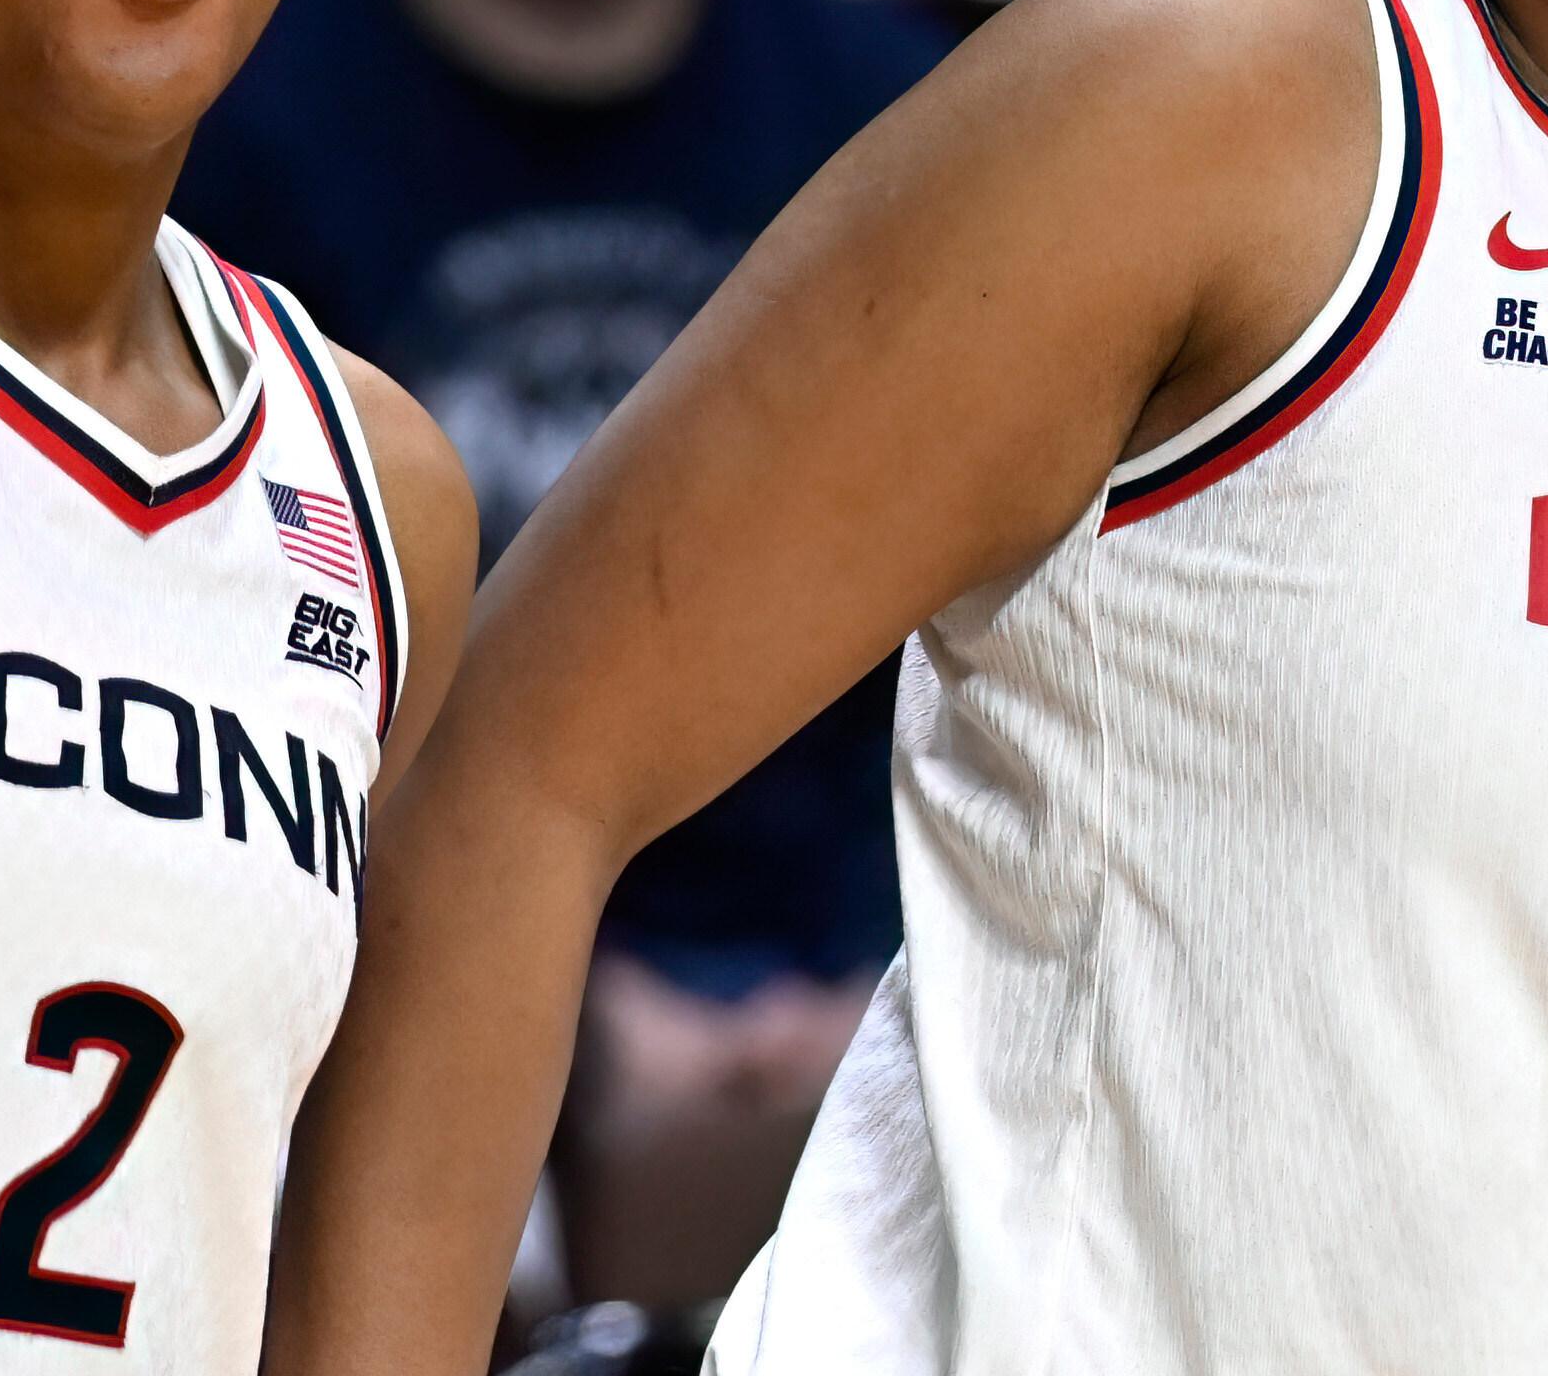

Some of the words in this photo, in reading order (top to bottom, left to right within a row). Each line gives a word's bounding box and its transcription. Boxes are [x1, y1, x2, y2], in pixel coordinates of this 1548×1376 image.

[1495, 297, 1538, 332] BE
[294, 592, 357, 639] BIG
[287, 621, 371, 676] EAST
